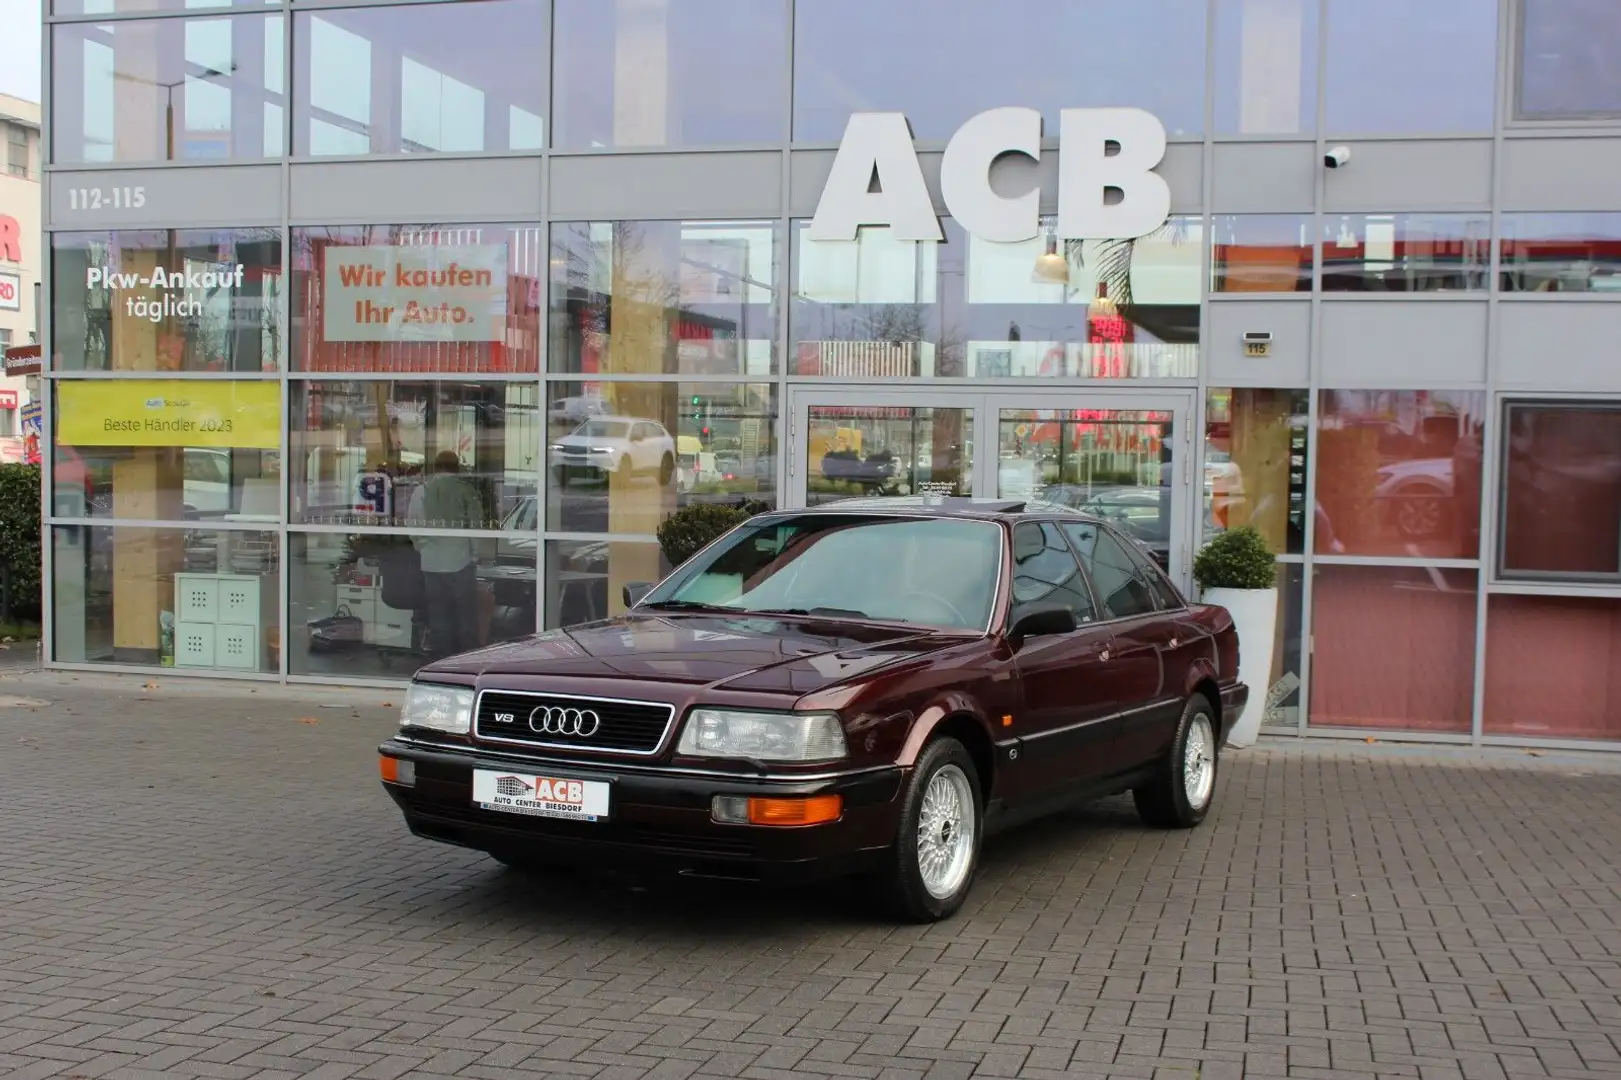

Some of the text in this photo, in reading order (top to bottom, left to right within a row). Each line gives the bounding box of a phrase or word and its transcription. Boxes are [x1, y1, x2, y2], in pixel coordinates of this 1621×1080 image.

[808, 106, 1171, 243] ACB
[69, 186, 146, 209] 112-115
[87, 264, 245, 290] Pkw-Ankauf
[339, 263, 492, 288] Wir kaufen
[126, 293, 202, 323] täglich
[355, 300, 476, 324] Ihr Auto.
[1248, 343, 1266, 354] 115
[104, 417, 233, 432] Beste Händler 2023
[494, 713, 515, 723] V8
[537, 779, 584, 803] ACB
[494, 796, 582, 813] AUTO CENTER BIESDORF
